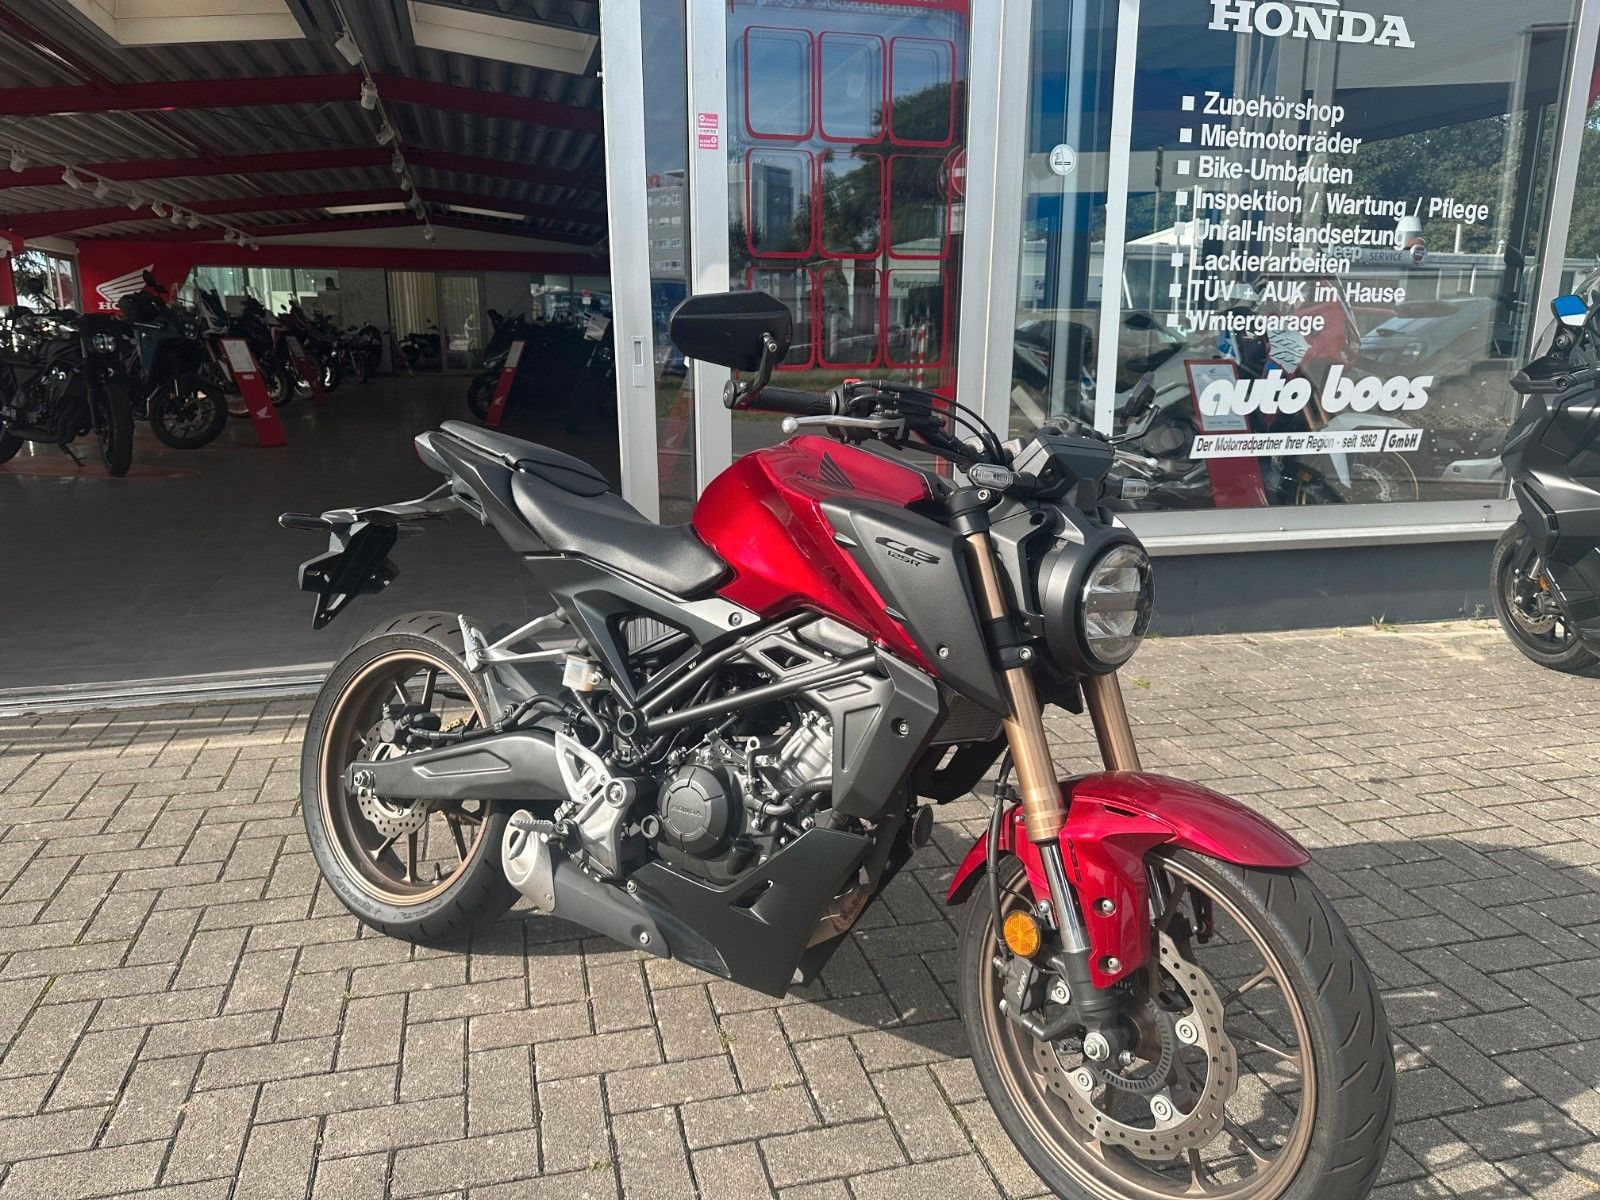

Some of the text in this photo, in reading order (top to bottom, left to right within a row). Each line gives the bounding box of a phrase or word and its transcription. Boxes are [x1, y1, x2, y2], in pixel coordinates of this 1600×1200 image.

[1208, 0, 1415, 49] HONDA
[1203, 91, 1345, 127] Zubehörshop
[1200, 124, 1362, 155] Mietmotorräder
[1198, 156, 1353, 185] Bike-Umbauten
[1196, 187, 1489, 225] Inspektion / Wartung / Pflege
[1196, 219, 1406, 250] Unfall-Instandsetzung
[1190, 251, 1351, 274] Lackierarbeiten
[1369, 251, 1403, 261] SERVICE
[1191, 276, 1235, 302] TÜV
[1261, 281, 1306, 303] AUK
[1315, 282, 1338, 302] im
[1347, 282, 1406, 303] Hause
[1190, 310, 1325, 336] Wintergarage
[1199, 364, 1434, 416] auto boos
[1196, 438, 1213, 452] Der
[1214, 436, 1283, 453] Motorradpartner
[1285, 435, 1304, 449] Ihrer
[1306, 434, 1334, 452] Region
[1342, 434, 1358, 449] seit
[1360, 434, 1377, 447] 1982
[1388, 433, 1418, 448] GmbH
[875, 536, 941, 565] CB
[887, 550, 921, 567] 125R
